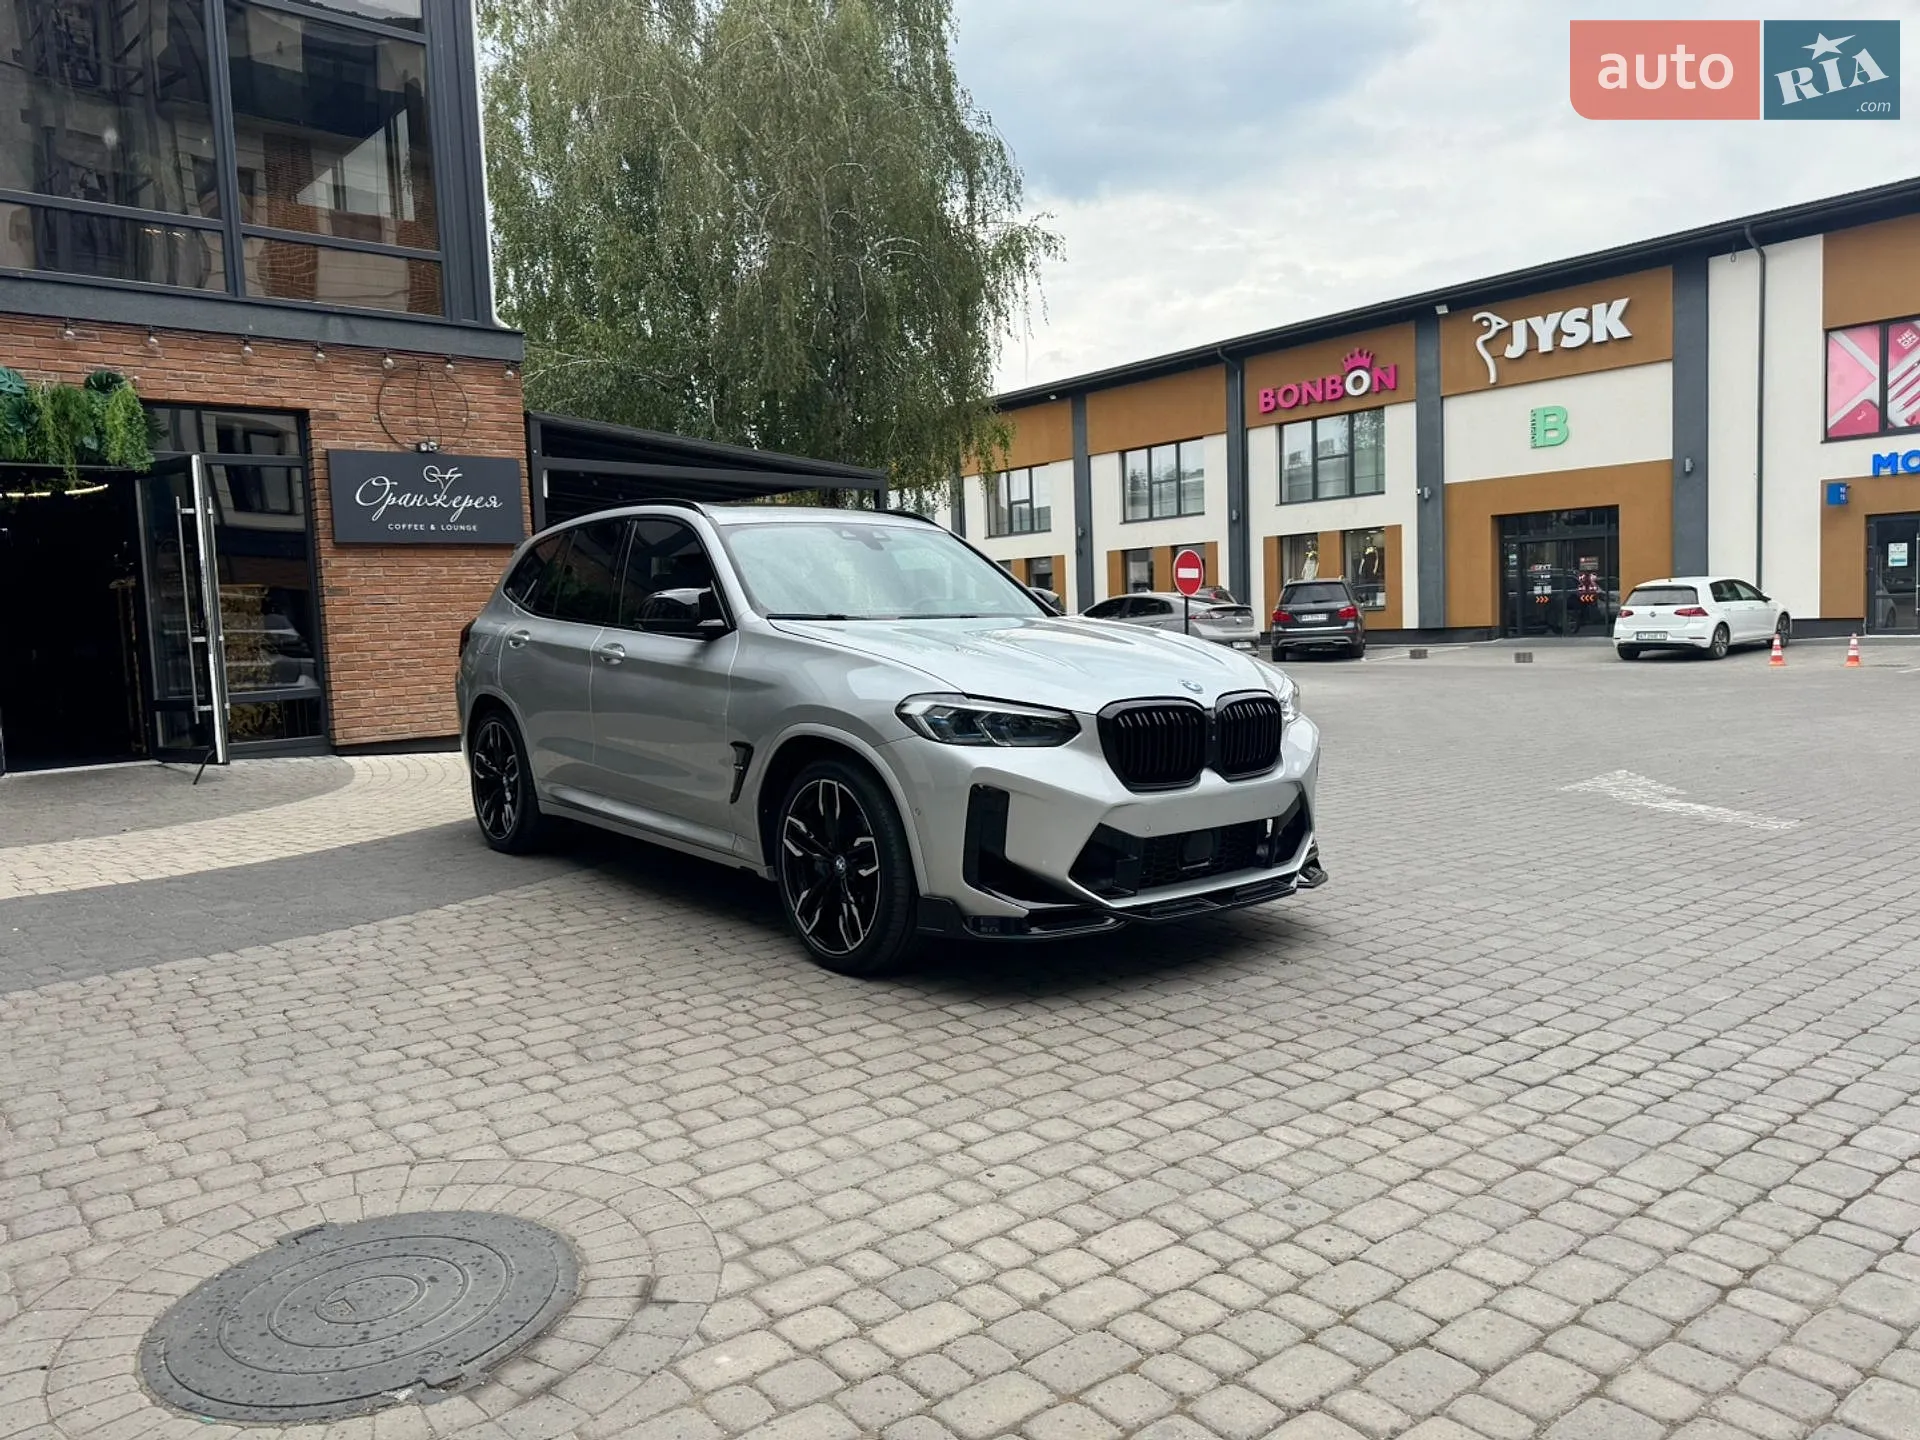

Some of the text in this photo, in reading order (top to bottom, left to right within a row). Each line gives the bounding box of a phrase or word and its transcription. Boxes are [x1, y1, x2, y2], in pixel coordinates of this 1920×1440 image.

[1504, 297, 1633, 359] JYSK
[1258, 363, 1398, 414] BONBON
[355, 474, 503, 522] Оранжерея
[387, 523, 478, 533] COFFEE & LOUNGE
